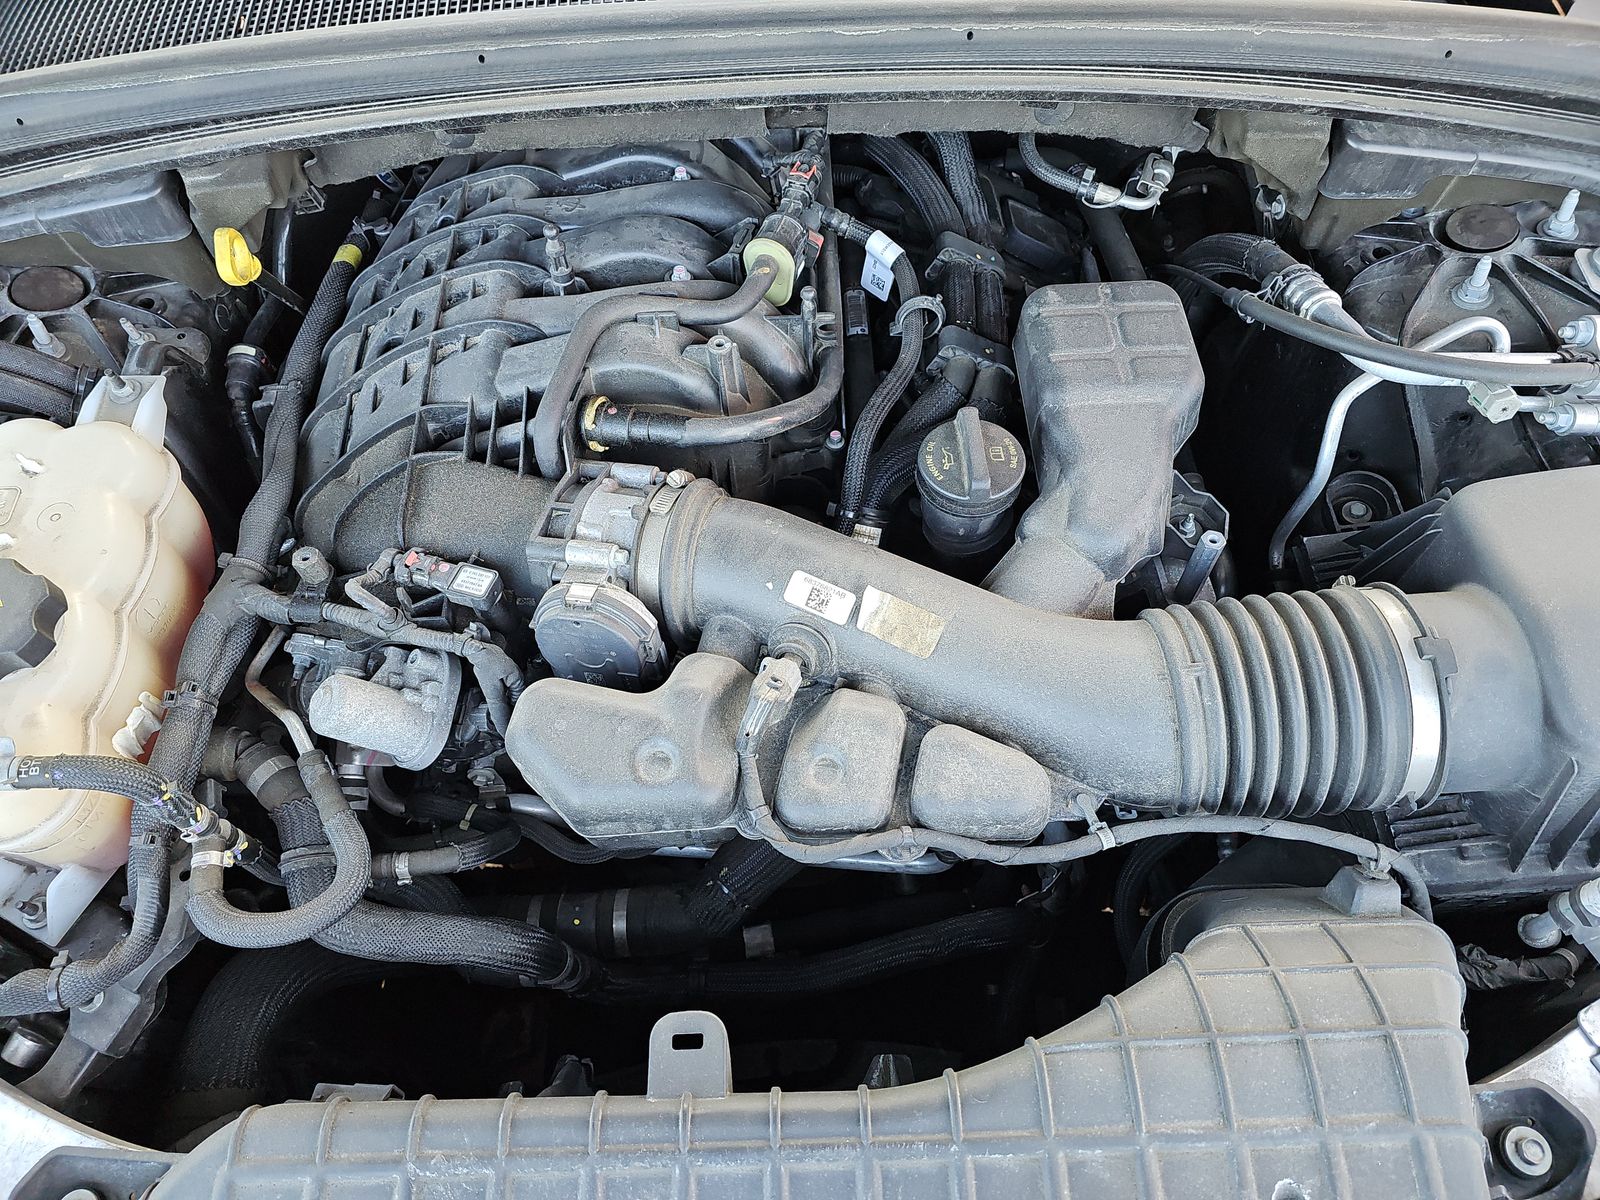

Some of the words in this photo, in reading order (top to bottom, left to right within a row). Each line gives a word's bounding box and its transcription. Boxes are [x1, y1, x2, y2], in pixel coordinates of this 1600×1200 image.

[926, 441, 936, 452] OIL
[925, 454, 944, 481] ENGINE
[1009, 455, 1019, 468] SAE
[19, 758, 31, 778] HO
[29, 758, 43, 776] BT
